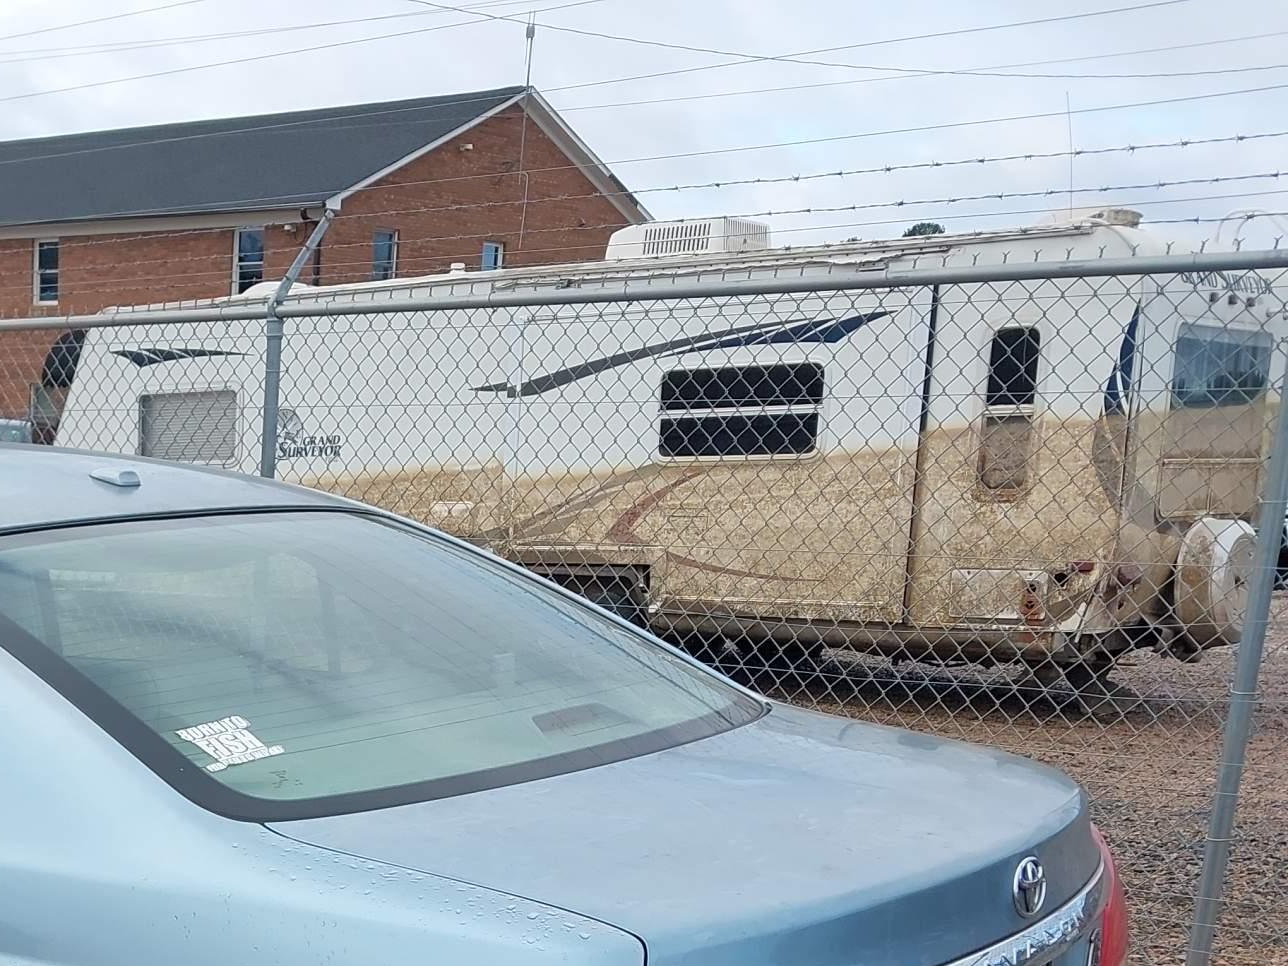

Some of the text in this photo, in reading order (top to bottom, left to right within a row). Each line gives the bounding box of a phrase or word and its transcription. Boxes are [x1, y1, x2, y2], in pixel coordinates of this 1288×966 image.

[302, 434, 341, 447] GRAND
[278, 441, 342, 458] SURVEYOR
[192, 728, 266, 760] FISH
